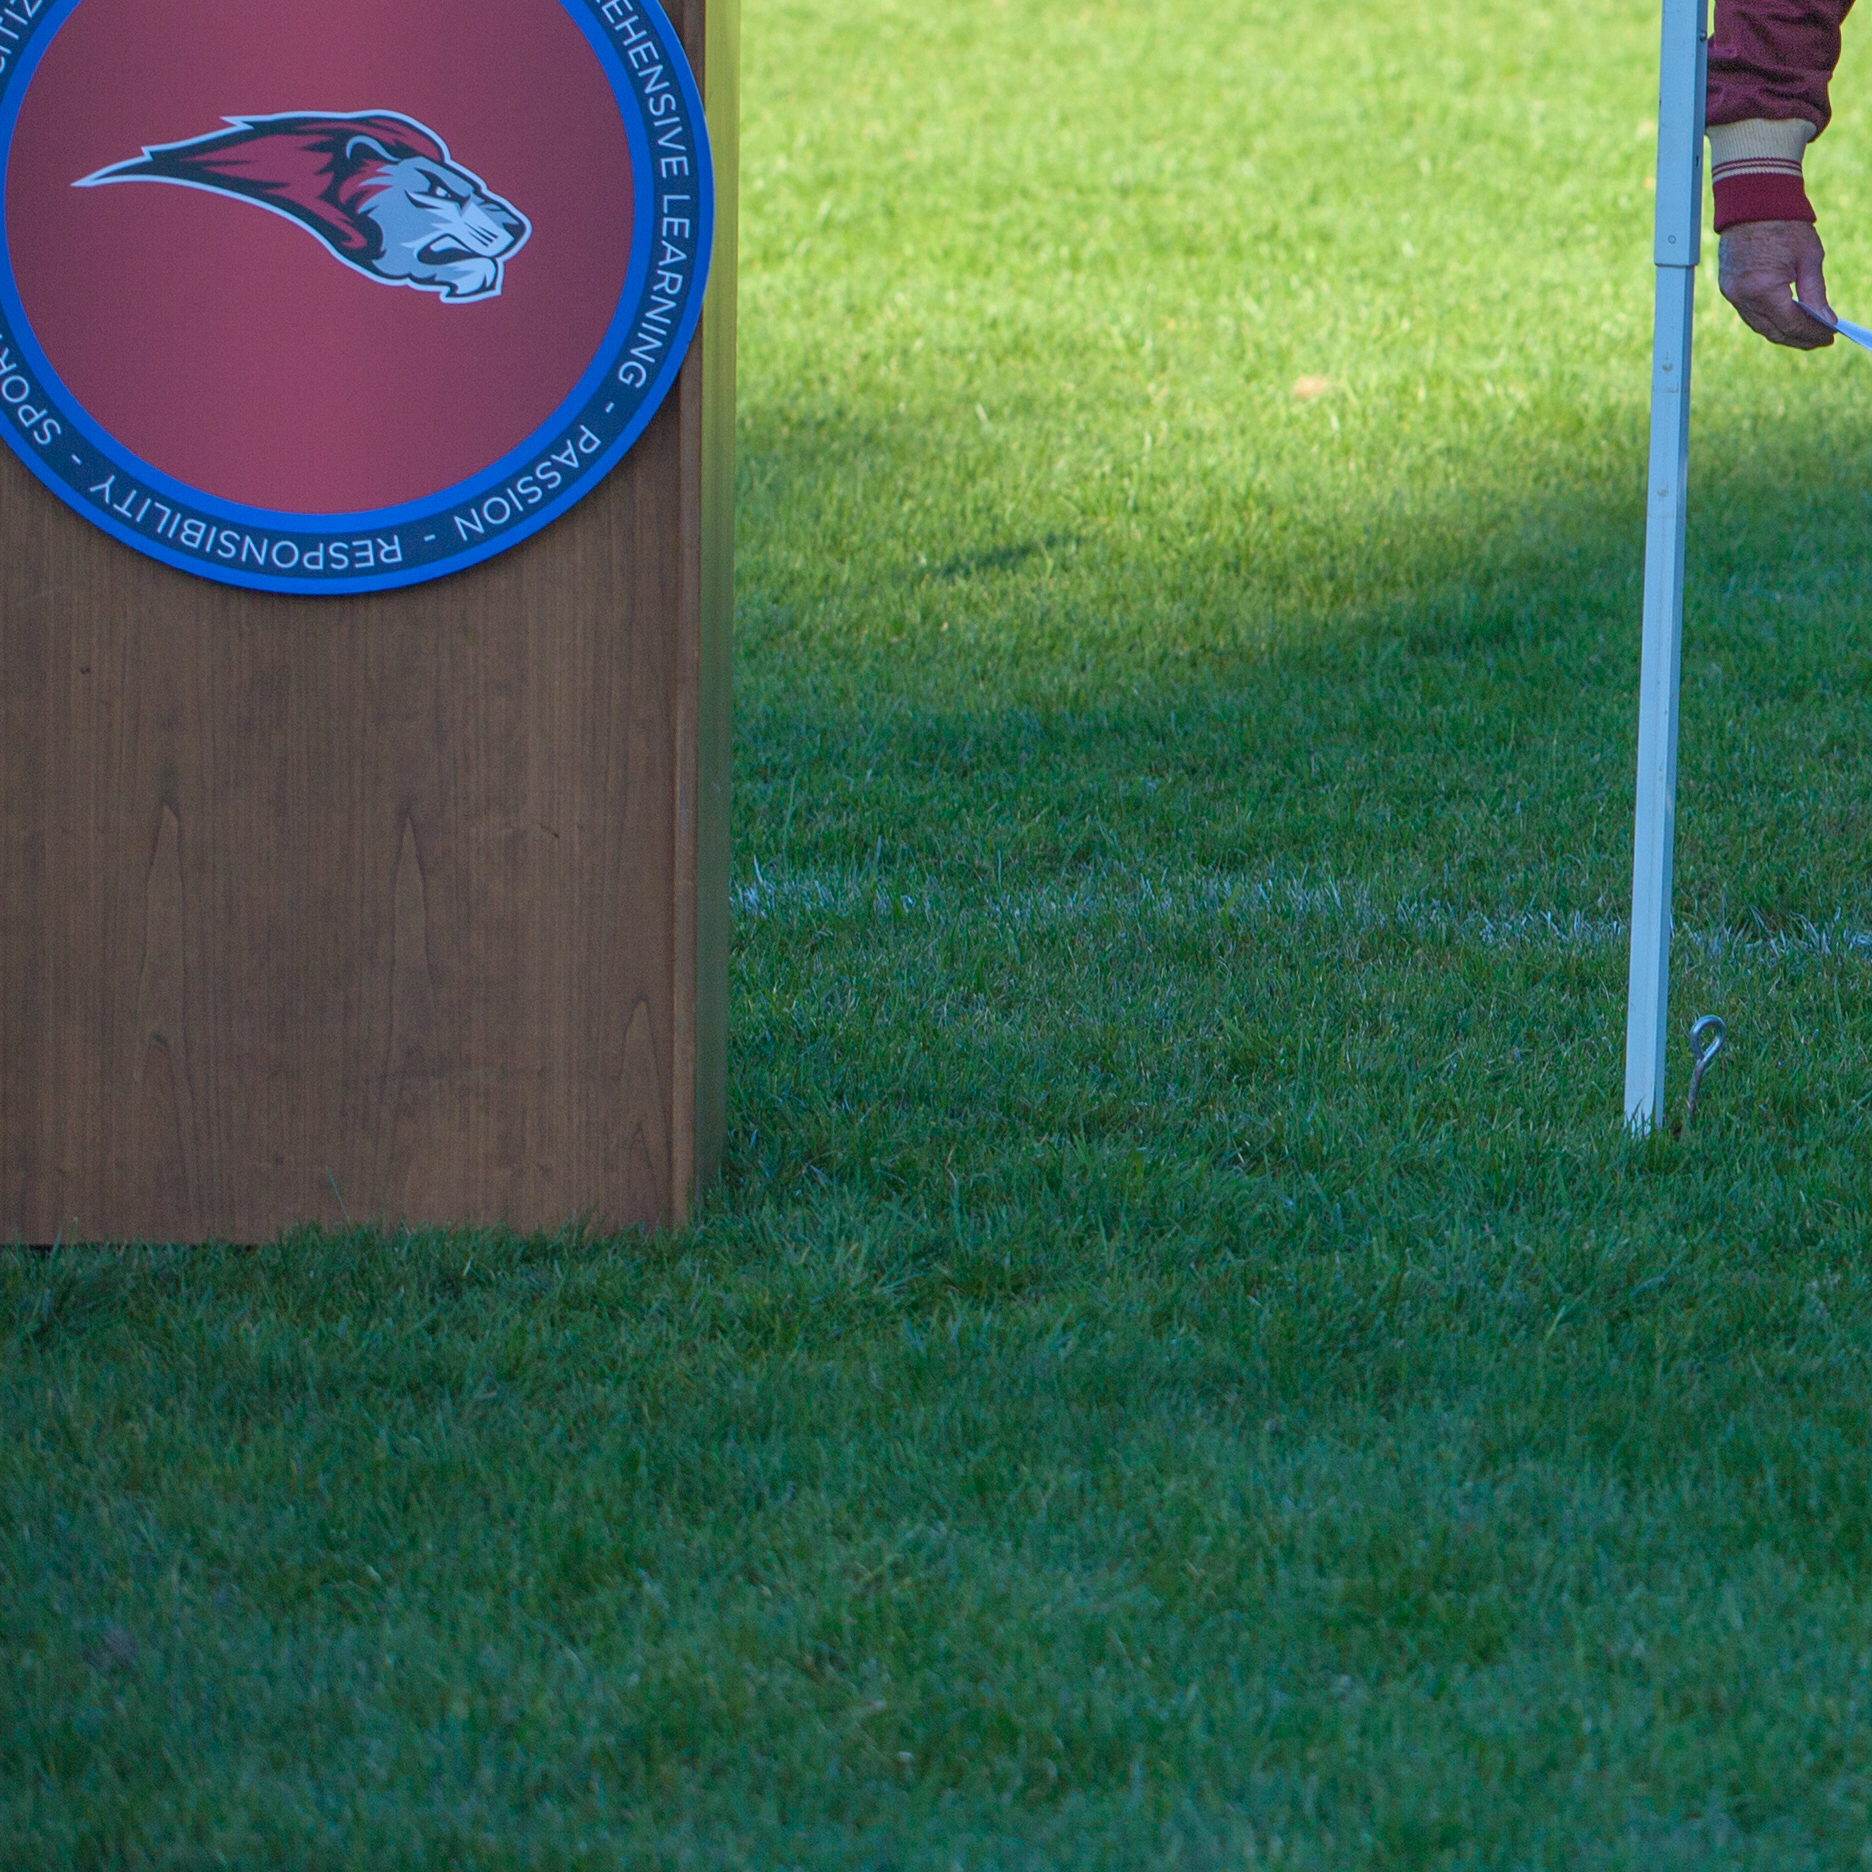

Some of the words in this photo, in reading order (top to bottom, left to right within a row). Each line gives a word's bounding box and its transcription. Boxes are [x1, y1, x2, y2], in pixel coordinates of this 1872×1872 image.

[617, 193, 691, 388] LEARNING
[89, 474, 404, 570] RESPONSIBILITY
[453, 424, 602, 541] PASSION
